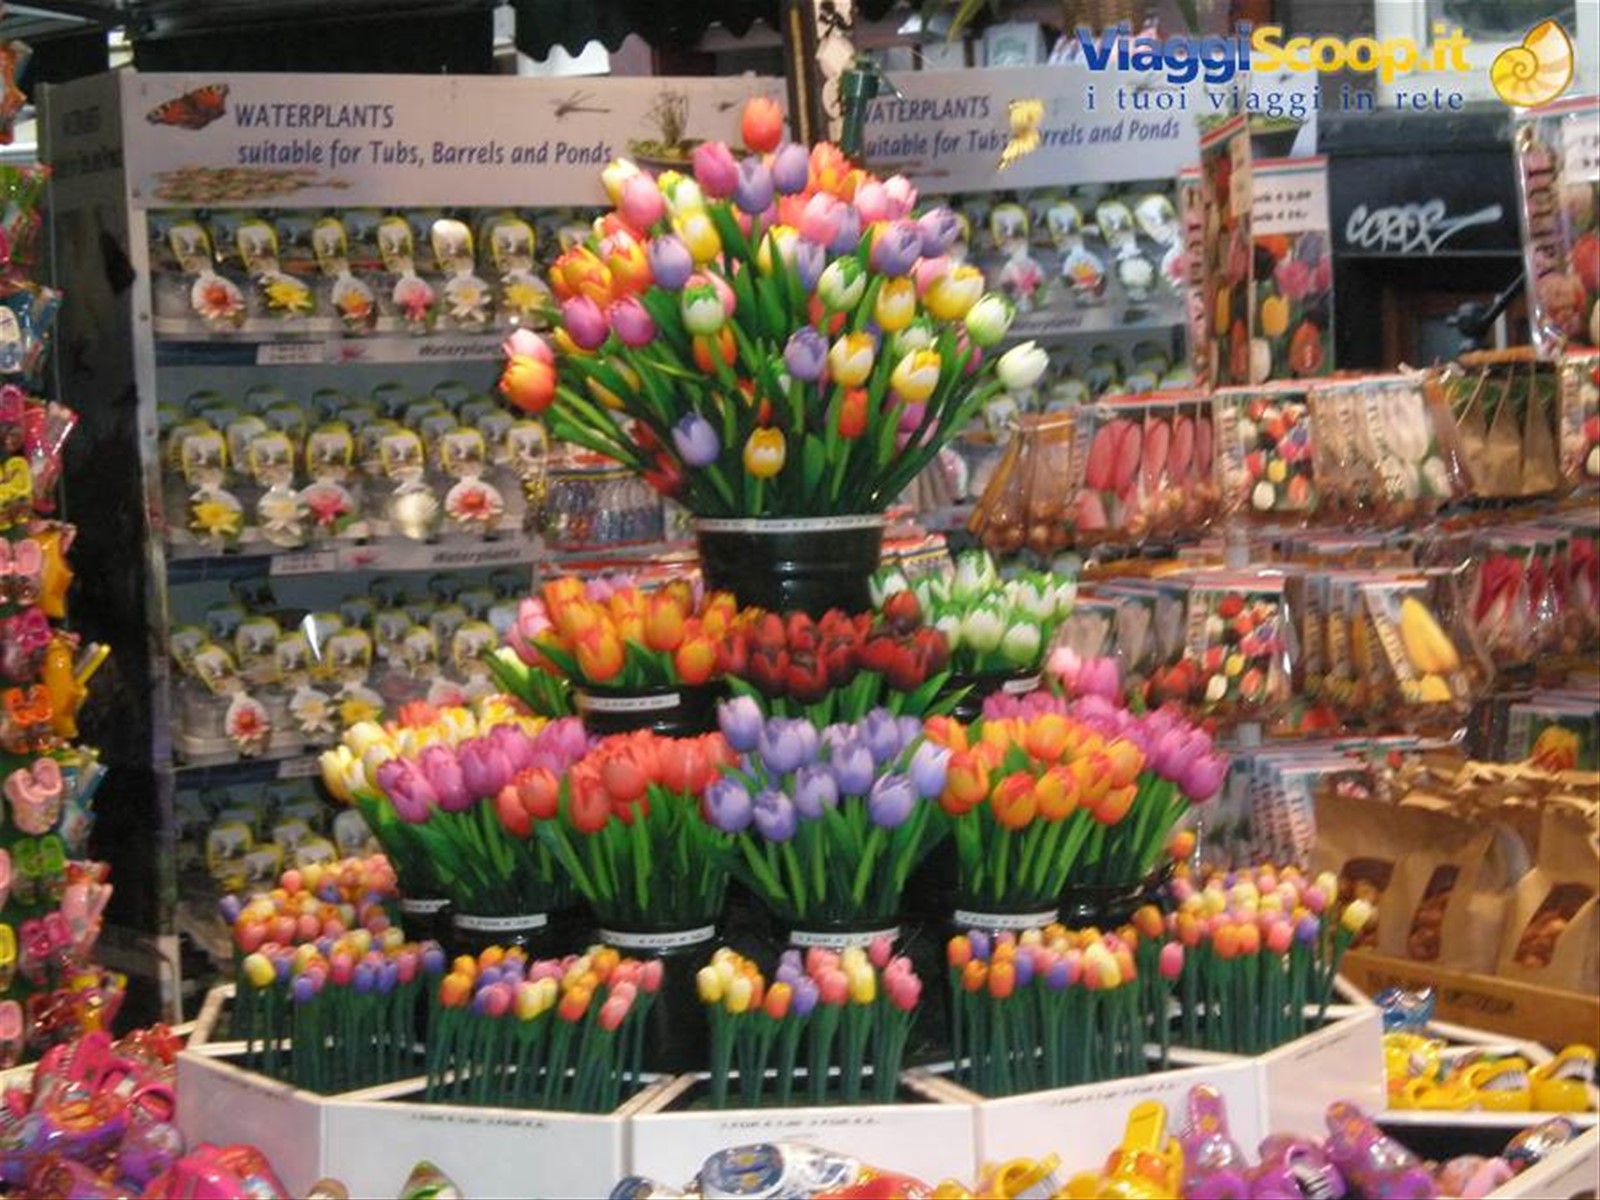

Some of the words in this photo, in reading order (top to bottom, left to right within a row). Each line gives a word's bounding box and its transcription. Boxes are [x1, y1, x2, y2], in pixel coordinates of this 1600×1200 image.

[235, 103, 394, 128] WATERPLANTS
[865, 132, 928, 157] uitable
[930, 129, 961, 158] for
[1088, 119, 1124, 144] and
[1127, 116, 1180, 142] Ponds
[237, 139, 323, 164] suitable
[329, 139, 361, 168] for
[369, 140, 425, 167] Tubs,
[432, 140, 504, 164] Barrels
[511, 140, 548, 164] and
[554, 140, 612, 164] Ponds
